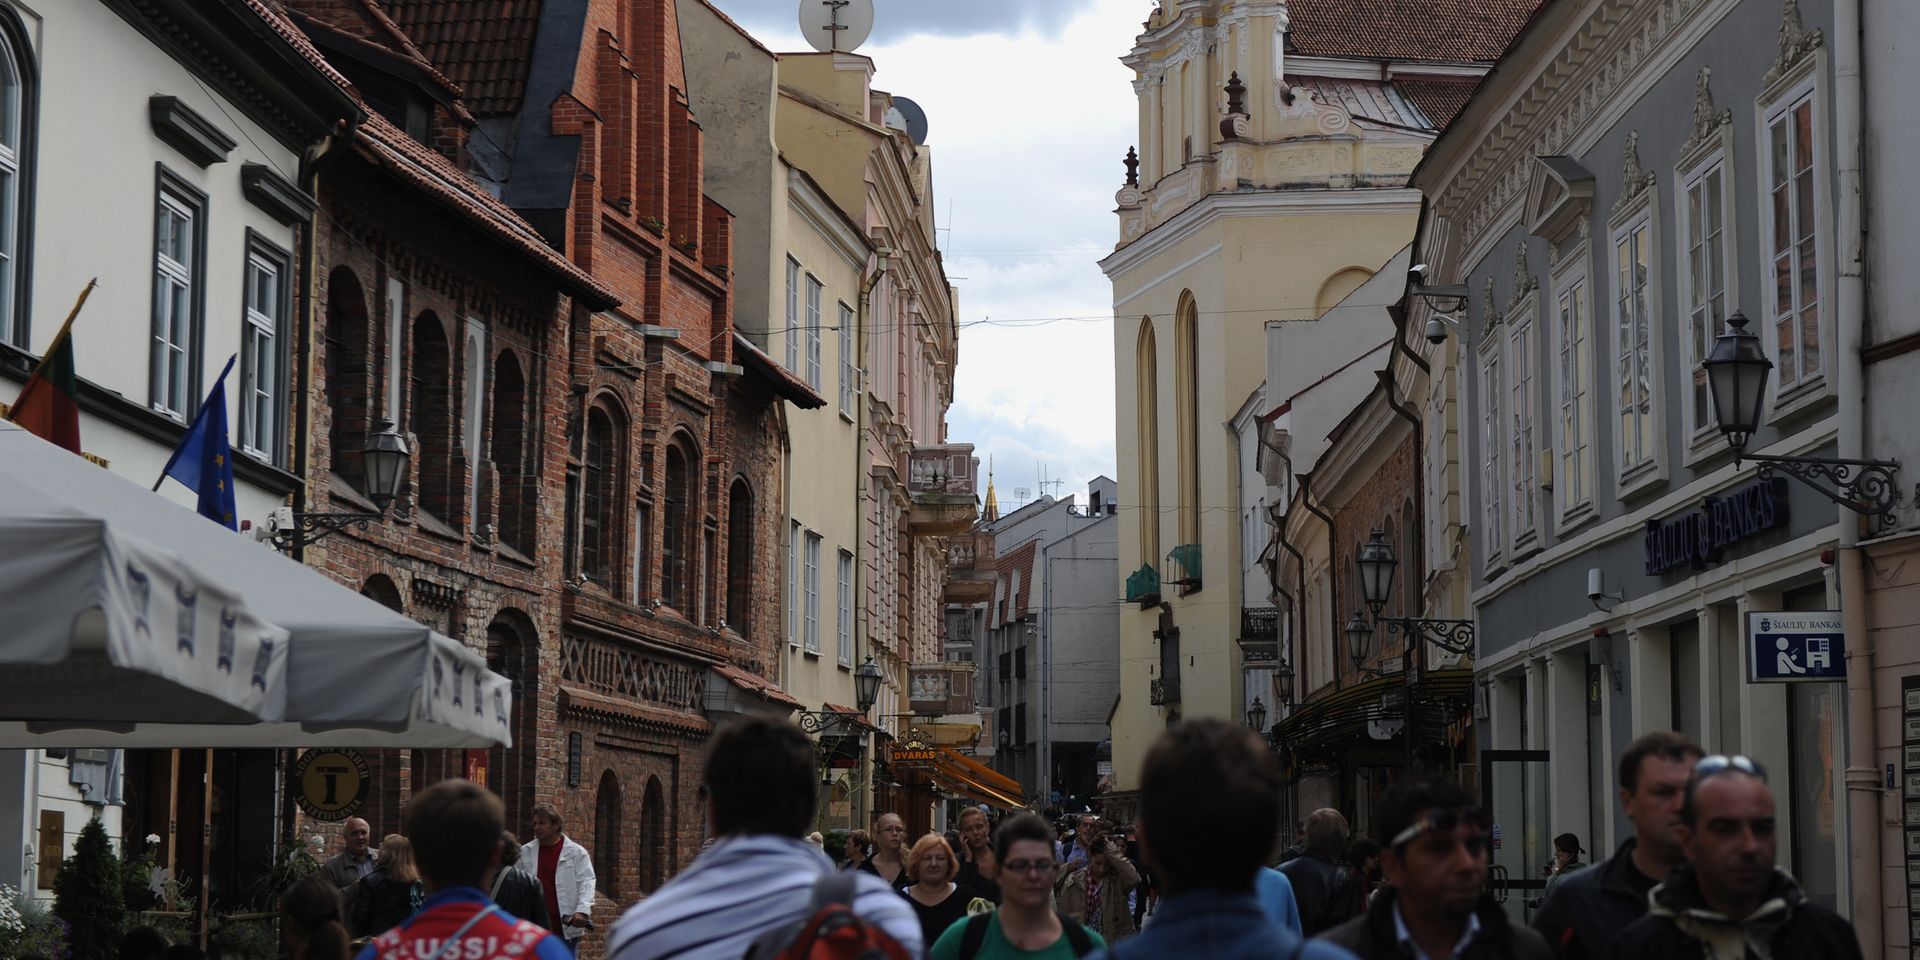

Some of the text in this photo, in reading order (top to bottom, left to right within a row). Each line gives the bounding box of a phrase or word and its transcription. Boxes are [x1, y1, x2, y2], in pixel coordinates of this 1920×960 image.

[1713, 480, 1776, 548] BANKAS
[1773, 619, 1842, 631] ŠIAULIŲ BANKAS
[894, 751, 936, 760] DVARAS
